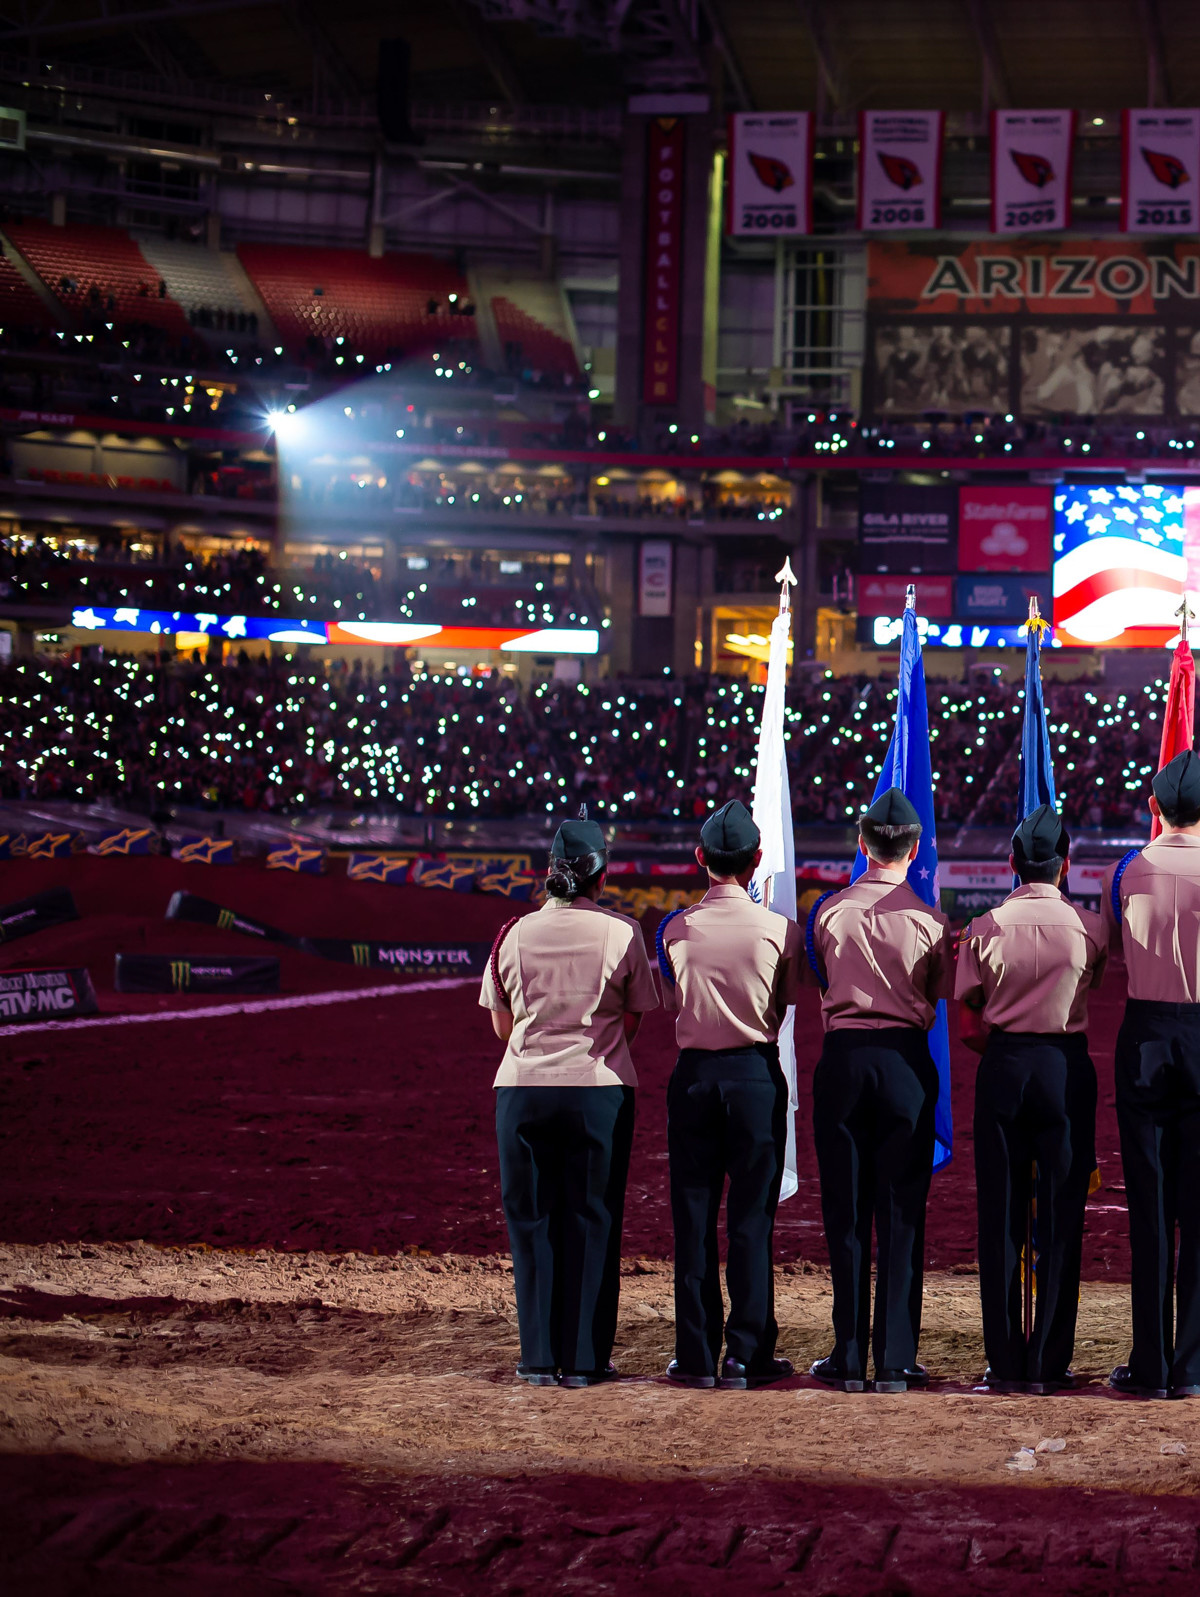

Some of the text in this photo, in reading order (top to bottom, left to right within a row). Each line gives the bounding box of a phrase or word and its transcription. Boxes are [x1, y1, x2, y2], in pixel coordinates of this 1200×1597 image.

[742, 213, 797, 228] 2008
[872, 208, 925, 223] 2008
[1005, 209, 1056, 226] 2009
[1136, 209, 1191, 225] 2015
[655, 146, 675, 311] FOOTBALL
[863, 514, 949, 525] GILA RIVER
[378, 947, 472, 966] MONSTER
